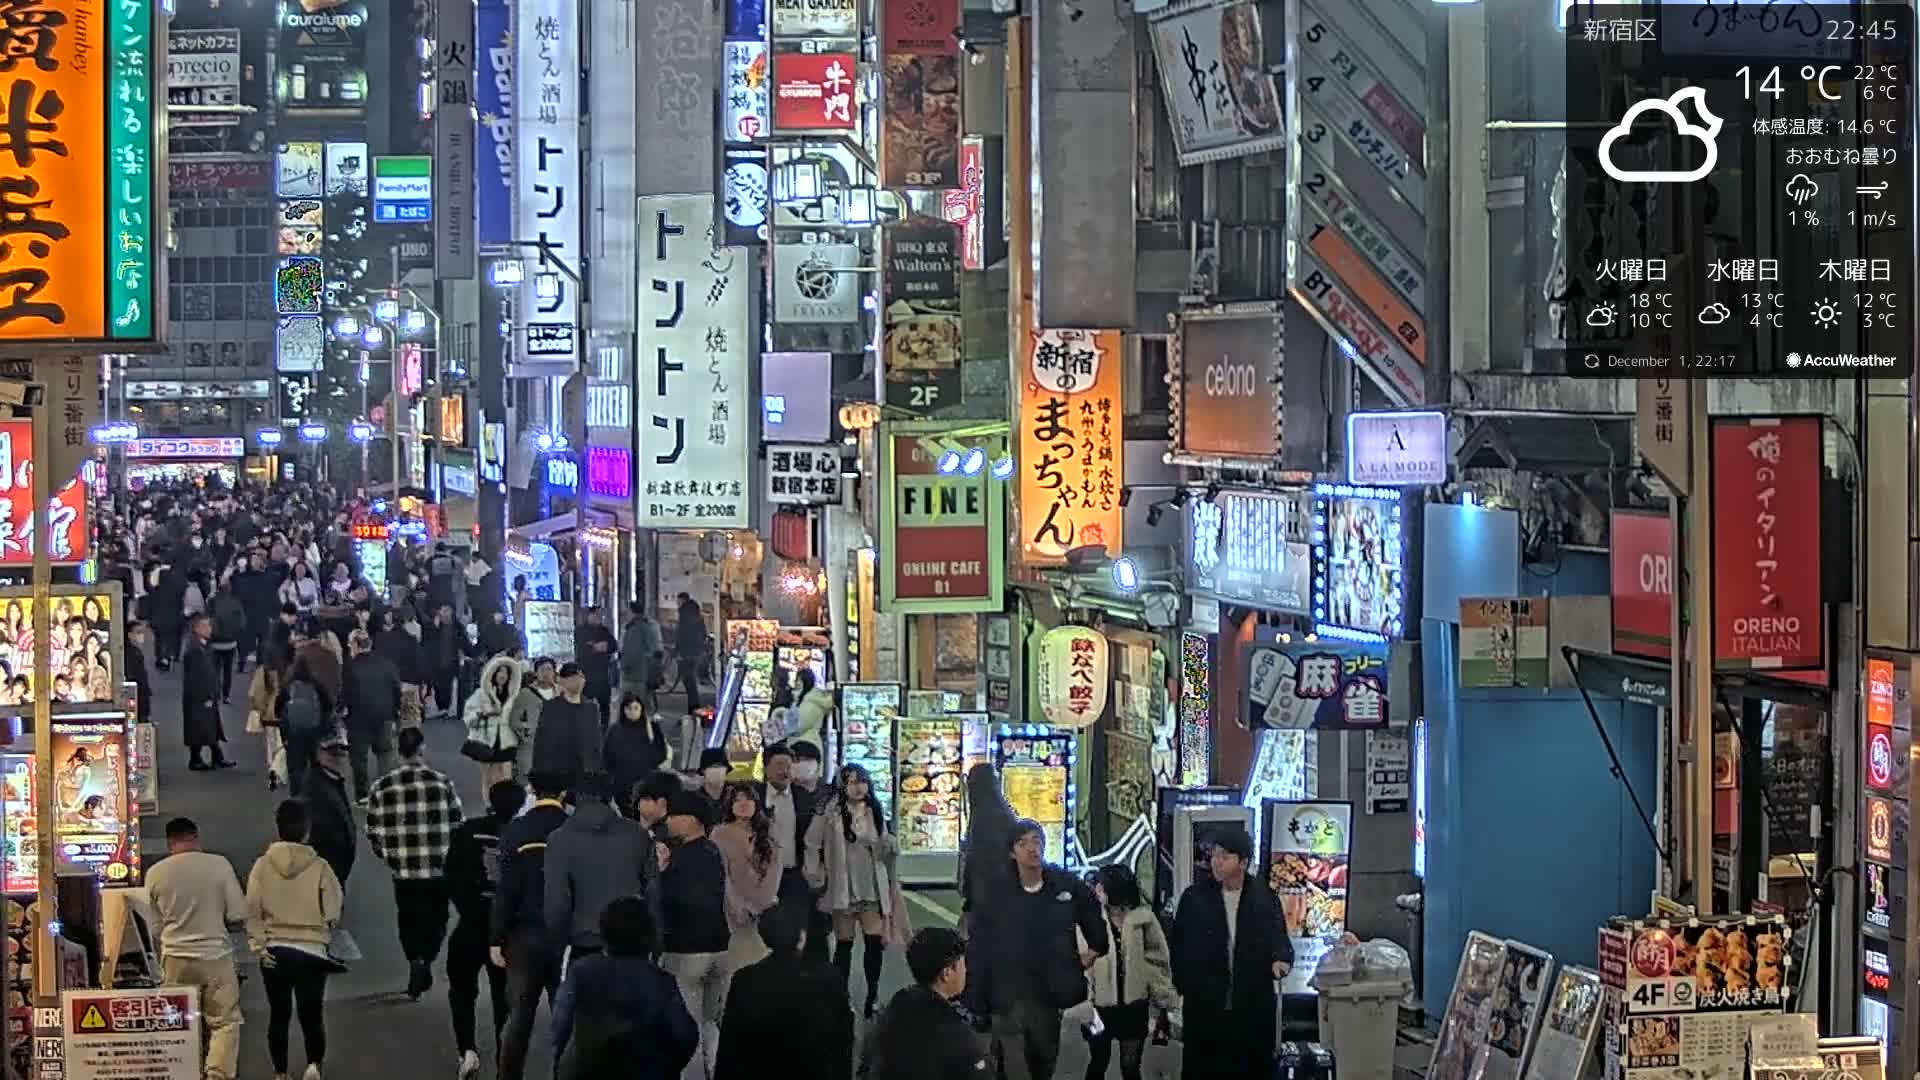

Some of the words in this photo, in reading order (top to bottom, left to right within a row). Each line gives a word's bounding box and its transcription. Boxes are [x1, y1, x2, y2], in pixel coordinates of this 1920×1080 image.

[287, 12, 362, 27] auralume
[1307, 22, 1326, 44] 5
[443, 41, 468, 105] 火鍋
[822, 60, 852, 123] 牛門
[1306, 75, 1325, 93] 4
[1307, 123, 1326, 144] 3
[378, 183, 429, 194] FamilyMart
[1306, 172, 1325, 195] 2
[893, 257, 952, 272] Walton's
[653, 210, 685, 465] トントン
[704, 326, 729, 446] 焼とん酒場
[1206, 355, 1257, 397] celona
[910, 386, 938, 406] 2F
[1386, 423, 1408, 451] A
[772, 452, 838, 472] 酒場心
[1033, 397, 1078, 548] まっちゃん
[645, 479, 743, 498] 新宿歌舞伎町店
[772, 477, 838, 496] 新宿本店
[904, 486, 979, 515] FINE
[1747, 432, 1781, 605] 俺のイタリアン
[903, 562, 946, 576] ONLINE
[951, 561, 981, 576] CAFE
[1734, 617, 1800, 634] ORENO
[1733, 634, 1801, 653] ITALIAN
[1296, 651, 1384, 723] 麻雀
[1633, 983, 1665, 1005] 4F
[1698, 987, 1780, 1007] 炭火焼き鳥
